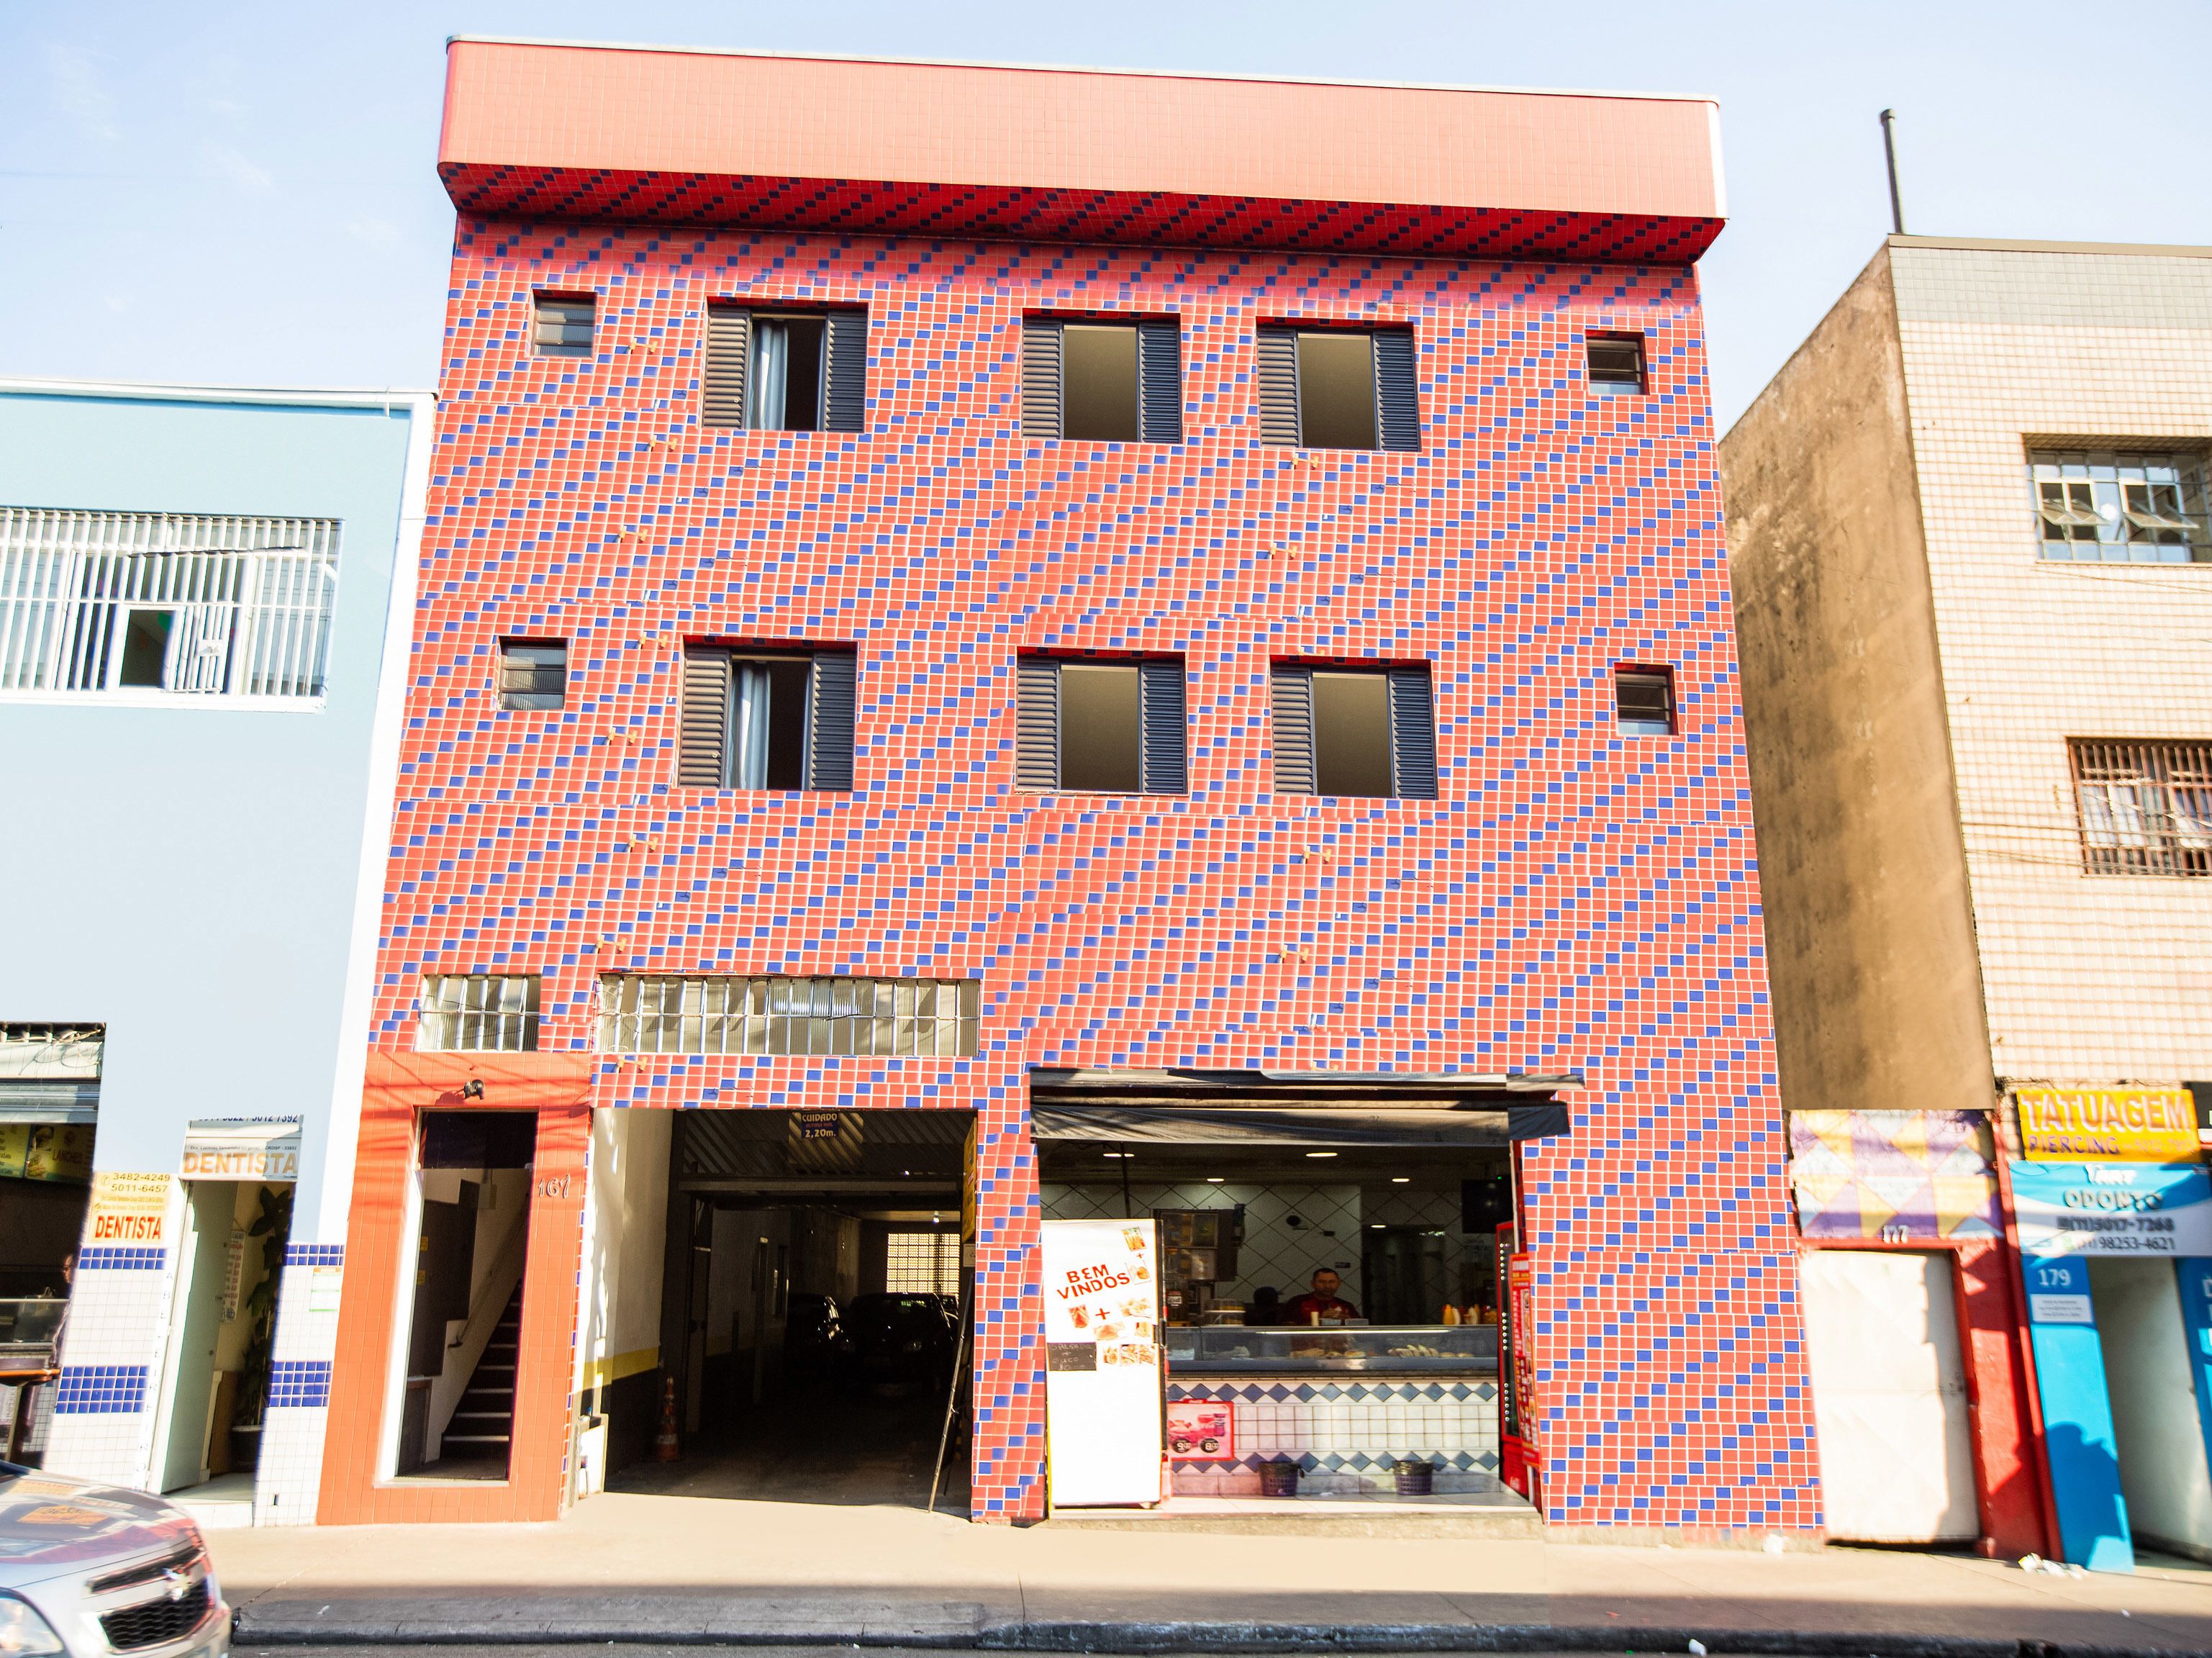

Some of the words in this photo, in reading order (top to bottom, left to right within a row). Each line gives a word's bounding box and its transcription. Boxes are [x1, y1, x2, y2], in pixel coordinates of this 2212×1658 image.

[802, 1113, 838, 1123] CUIDADO
[2019, 1093, 2191, 1133] TATUAGEM
[805, 1129, 836, 1138] 2,20m.
[2029, 1135, 2120, 1154] PIERCING
[183, 1152, 299, 1174] DENTISTA
[114, 1172, 171, 1181] 3482-4249
[538, 1174, 571, 1198] 167
[111, 1184, 168, 1192] 5011-6457
[2063, 1190, 2162, 1212] ODONTO
[94, 1215, 162, 1239] DENTISTA
[1882, 1224, 1909, 1244] 177
[1066, 1264, 1110, 1284] BEM
[2037, 1269, 2071, 1287] 179
[1056, 1272, 1130, 1300] VINDOS
